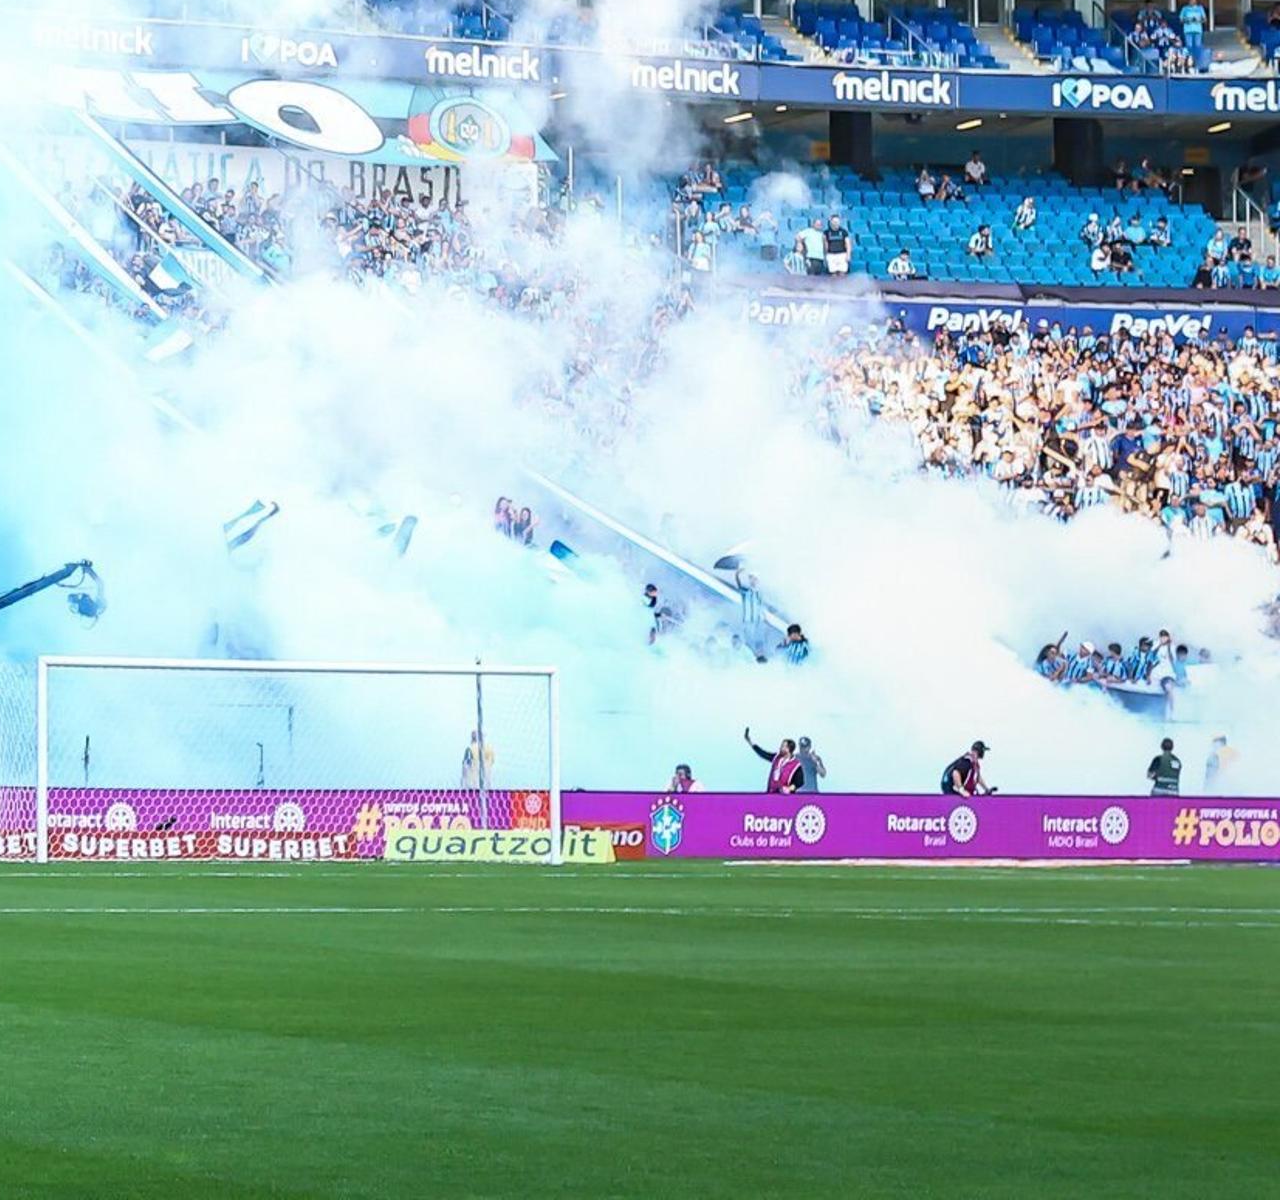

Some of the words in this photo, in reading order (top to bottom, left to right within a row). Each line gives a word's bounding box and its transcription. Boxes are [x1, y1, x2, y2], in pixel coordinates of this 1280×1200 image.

[281, 39, 337, 68] POA
[425, 44, 539, 82] melnick
[631, 60, 740, 95] melnick
[833, 69, 951, 105] melnick
[1092, 85, 1154, 110] POA
[350, 159, 468, 206] BRASIL
[48, 809, 102, 829] otaract
[210, 812, 272, 829] Interact
[744, 814, 793, 834] Rotary
[887, 814, 946, 832] Rotaract
[1043, 815, 1098, 833] Interact
[1199, 808, 1233, 819] JUNTOS
[1235, 808, 1268, 819] CONTRA
[1270, 809, 1278, 819] A
[63, 834, 196, 857] SUPERBET
[217, 834, 348, 859] SUPERBET
[396, 832, 597, 860] quartzoit
[730, 836, 754, 847] Clubs
[756, 836, 768, 847] do
[770, 835, 792, 847] Brasil
[924, 835, 946, 847] Brasil
[1075, 836, 1098, 848] Brasil
